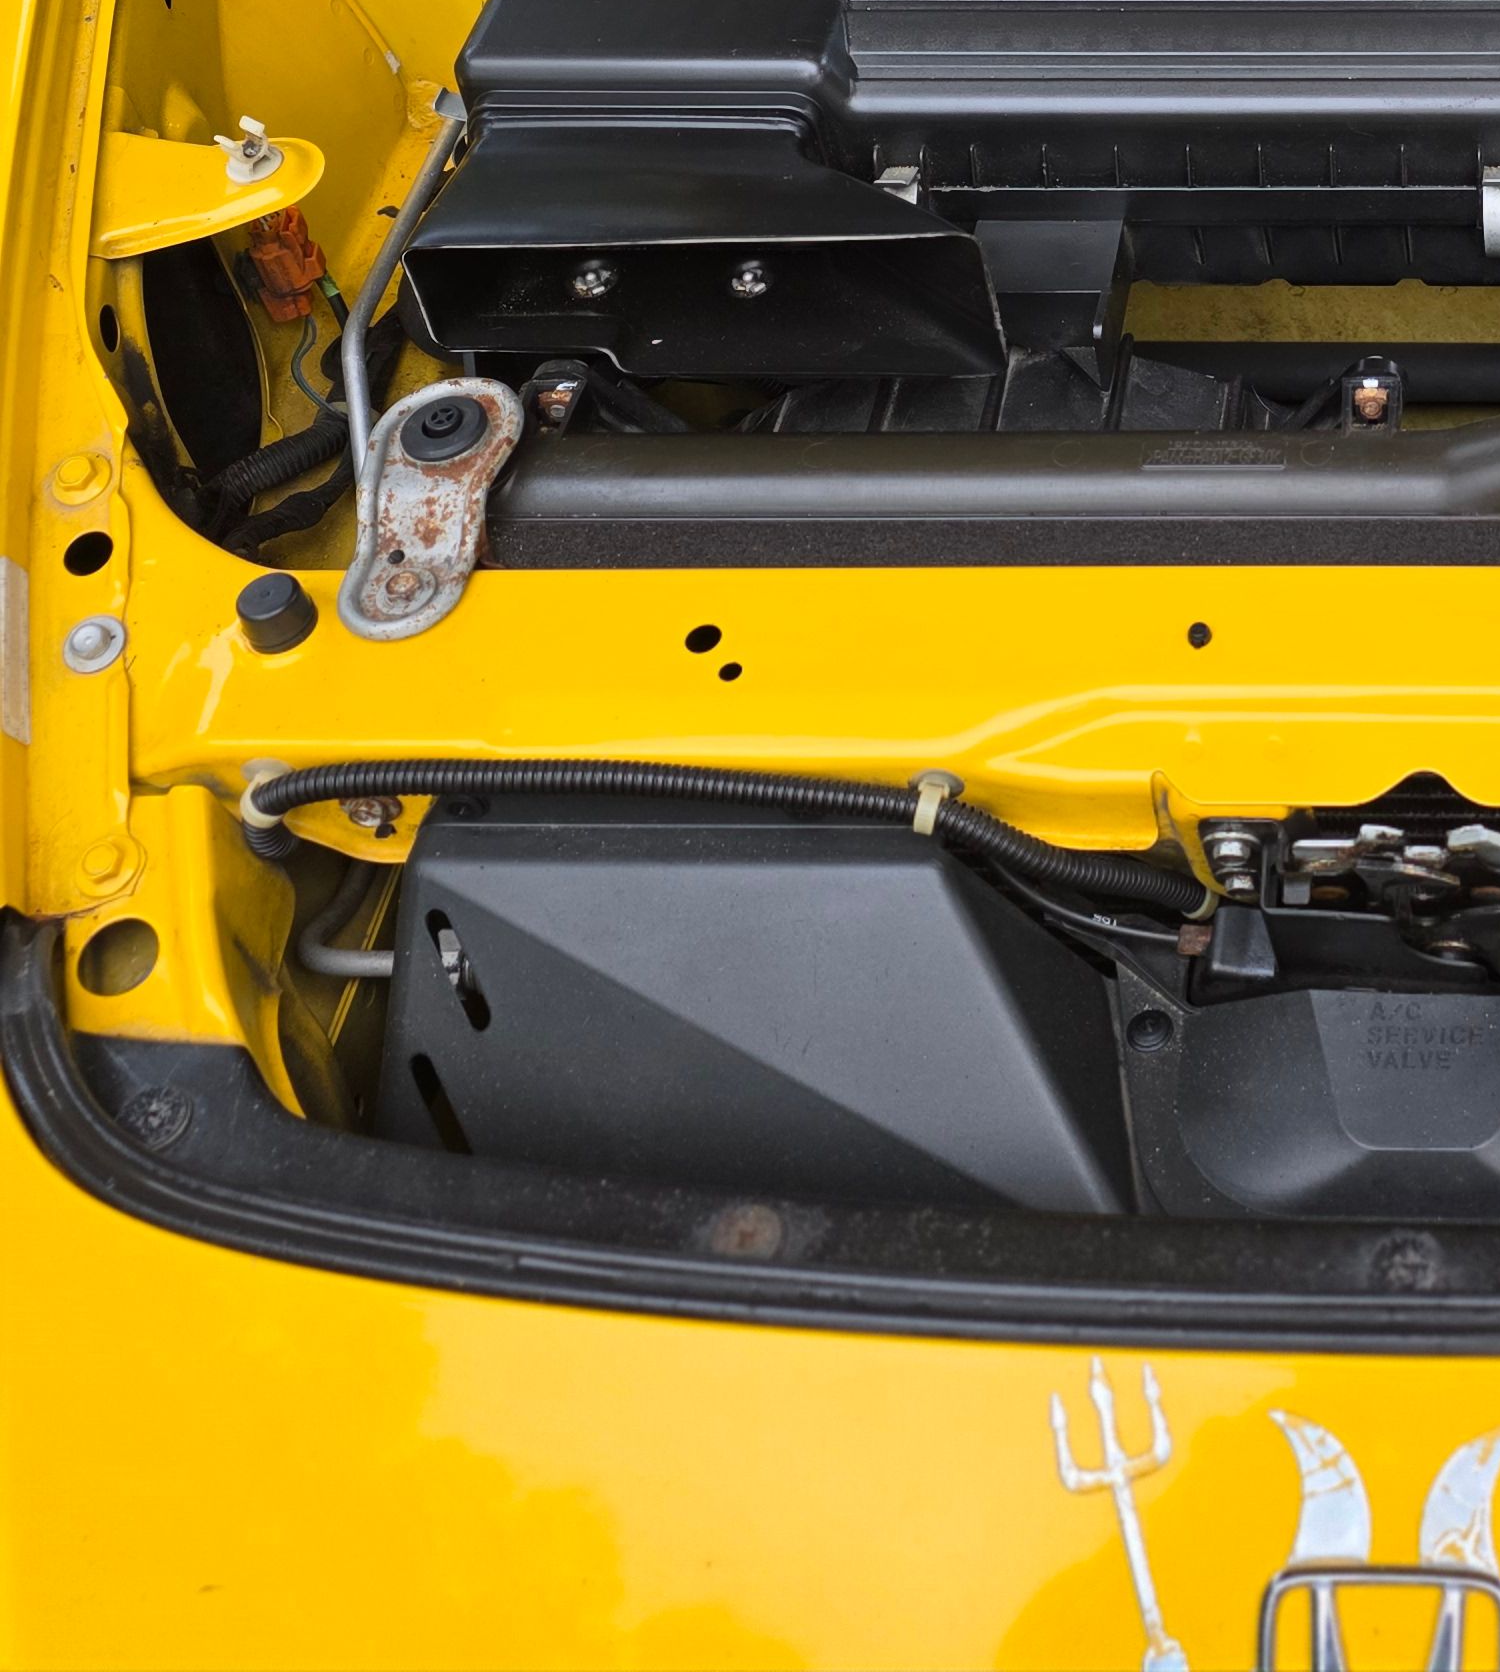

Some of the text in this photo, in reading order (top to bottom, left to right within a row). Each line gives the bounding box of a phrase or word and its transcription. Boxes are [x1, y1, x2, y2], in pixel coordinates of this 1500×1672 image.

[1370, 1001, 1422, 1021] A/C
[1367, 1027, 1484, 1045] SERVICE
[1366, 1050, 1451, 1070] VALVE
